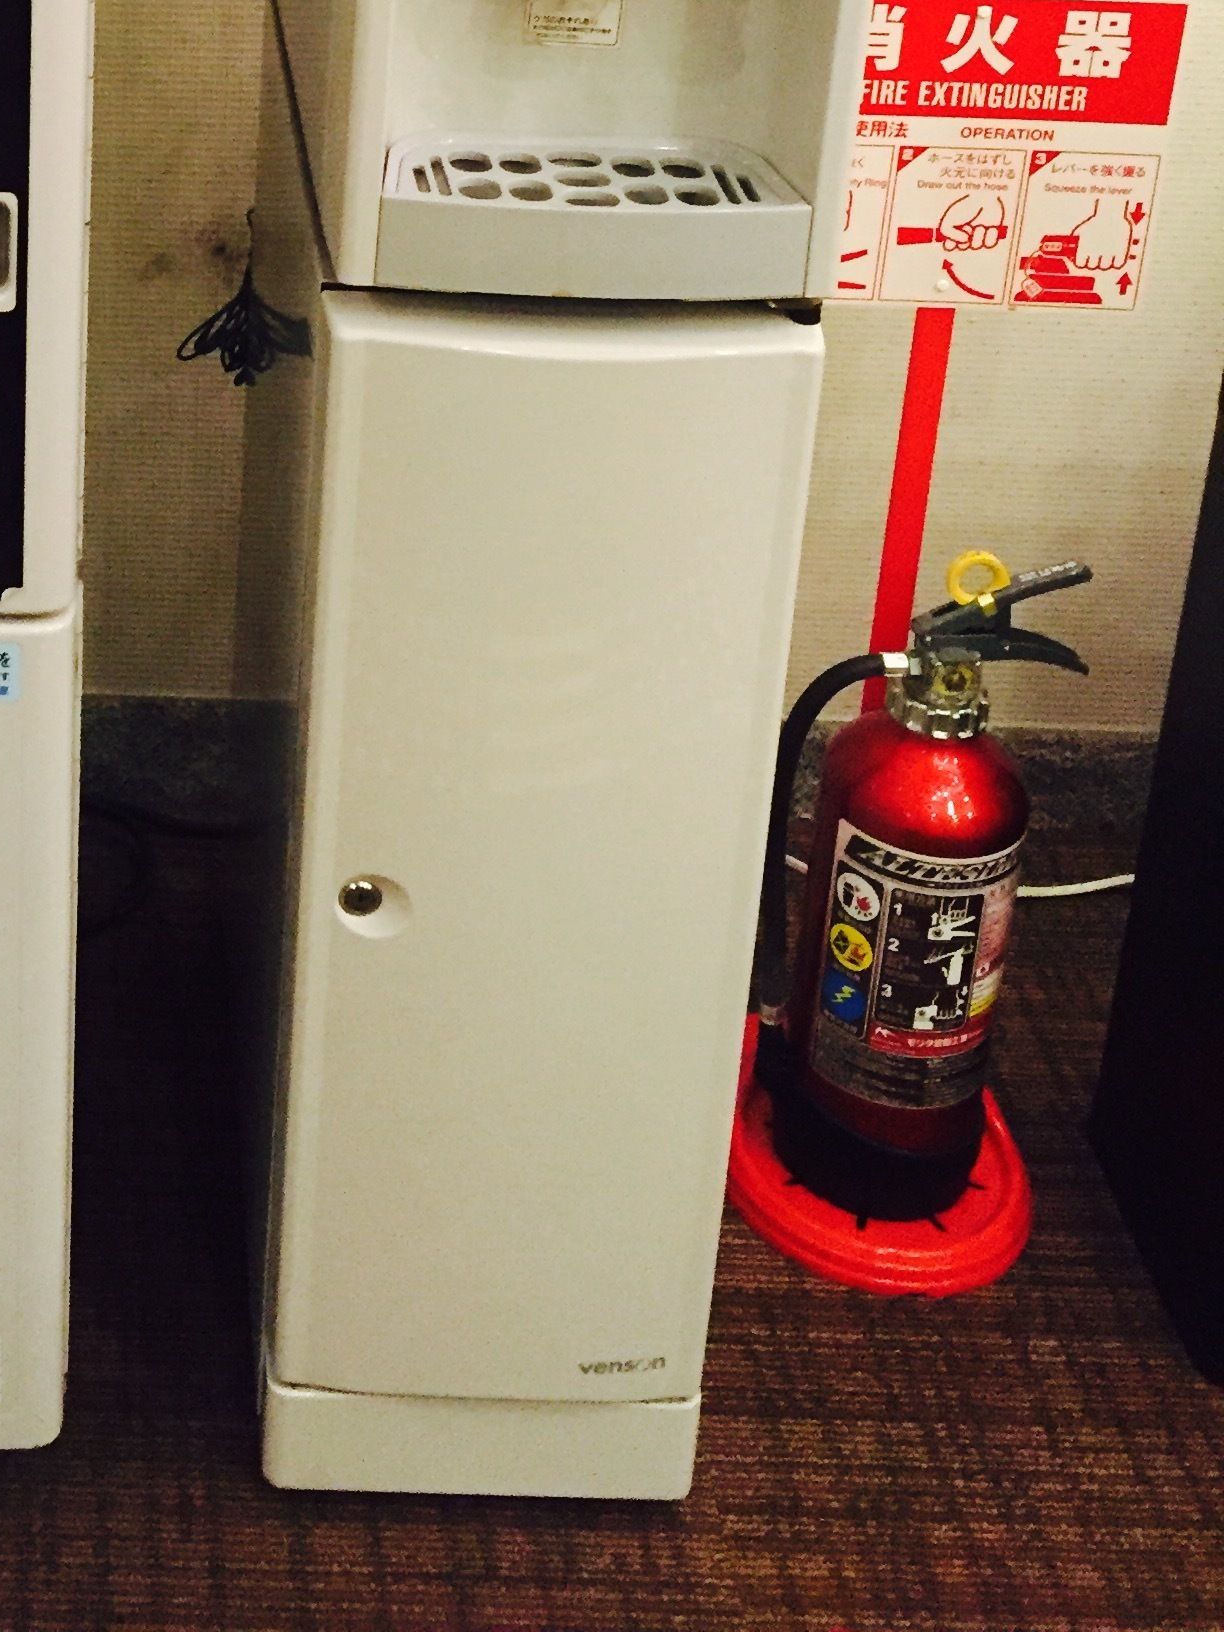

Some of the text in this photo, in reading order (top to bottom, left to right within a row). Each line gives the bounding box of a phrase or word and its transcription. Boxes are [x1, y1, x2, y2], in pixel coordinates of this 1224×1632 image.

[860, 79, 1089, 112] FIRE EXTINGUISHER
[960, 126, 1056, 142] OPERATION
[928, 153, 1013, 166] ホースをはずし
[940, 166, 1016, 180] 火元に向ける
